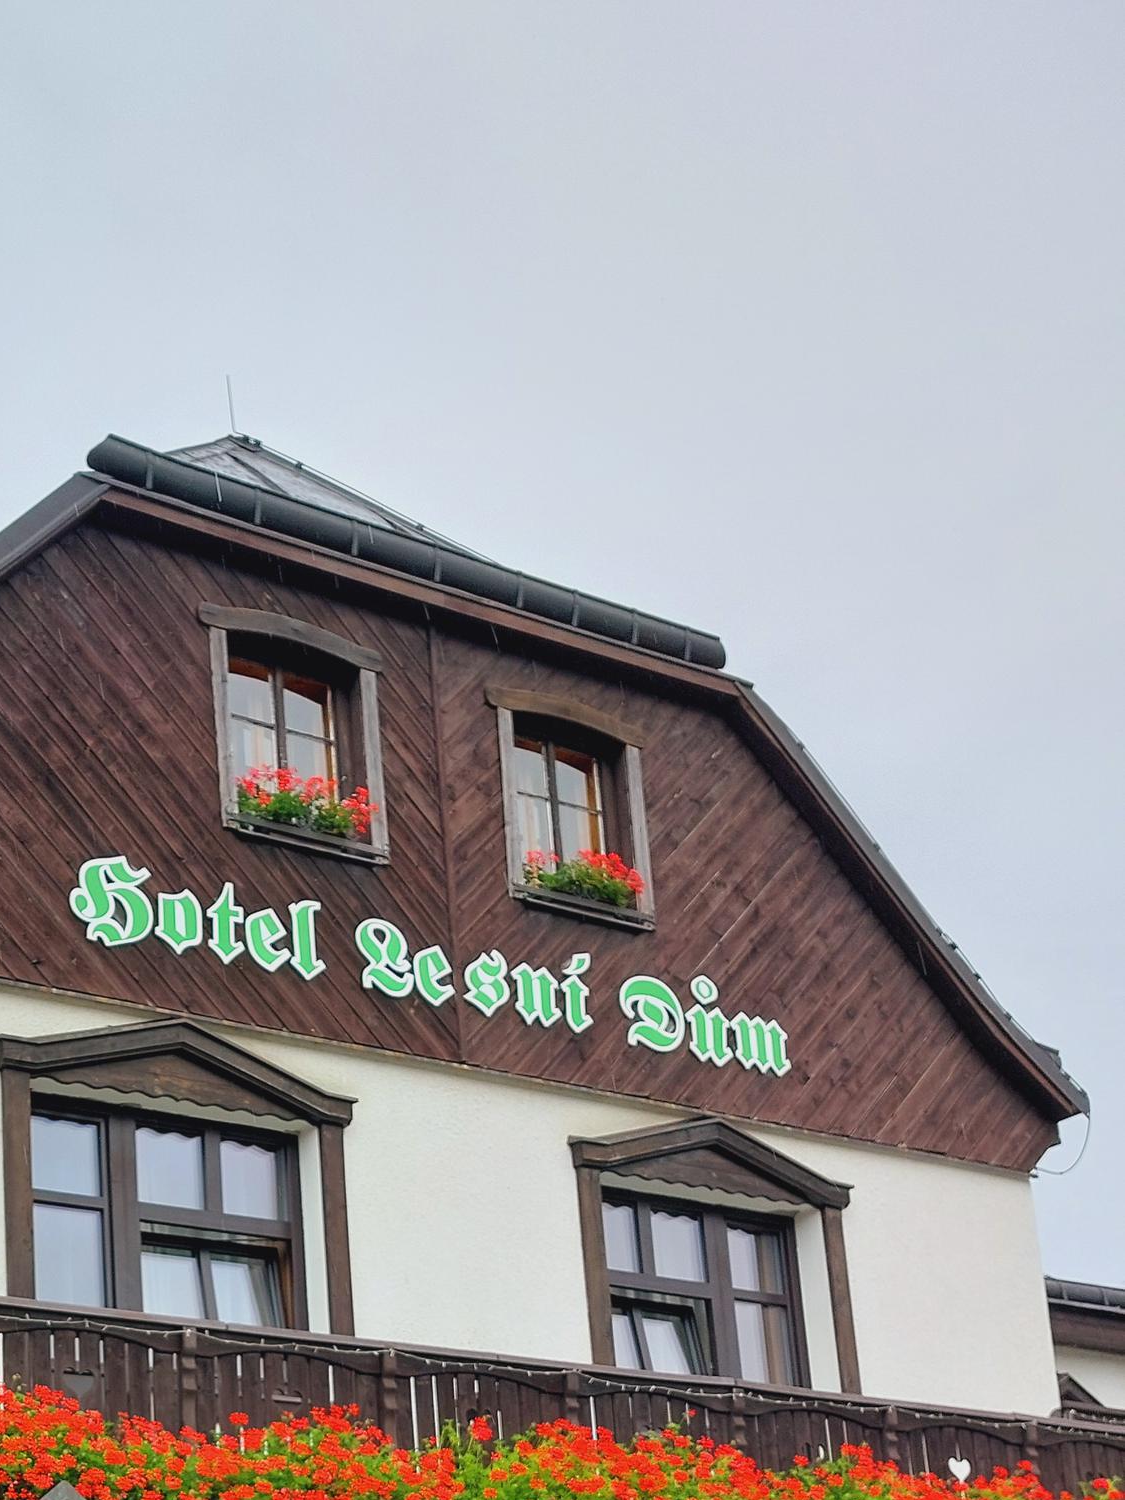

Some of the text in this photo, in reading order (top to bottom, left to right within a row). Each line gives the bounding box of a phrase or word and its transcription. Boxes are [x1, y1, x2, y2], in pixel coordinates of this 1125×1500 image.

[69, 855, 793, 1077] Hotel Lesní Dům
